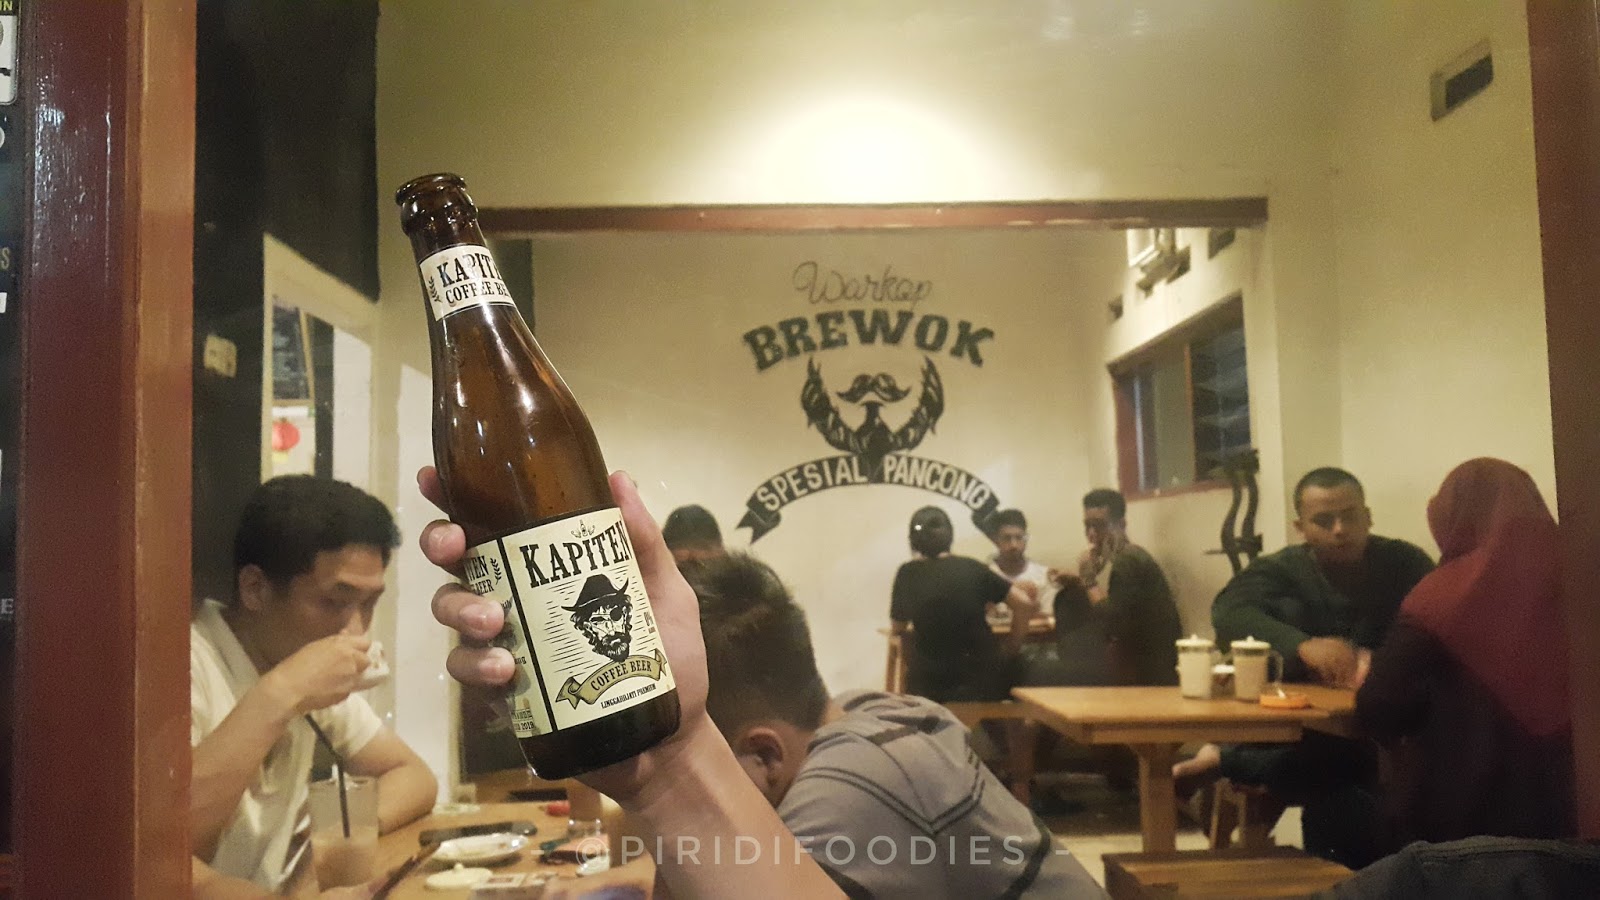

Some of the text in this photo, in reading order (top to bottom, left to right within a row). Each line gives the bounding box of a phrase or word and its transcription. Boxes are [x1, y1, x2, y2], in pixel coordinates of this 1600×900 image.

[445, 281, 495, 304] COFFEE
[793, 260, 933, 308] Warkop
[743, 308, 995, 373] BREWOK
[756, 454, 992, 512] SPESIAL PANCONG
[519, 520, 633, 589] KAPITEN
[590, 659, 652, 691] COFFEE BEER
